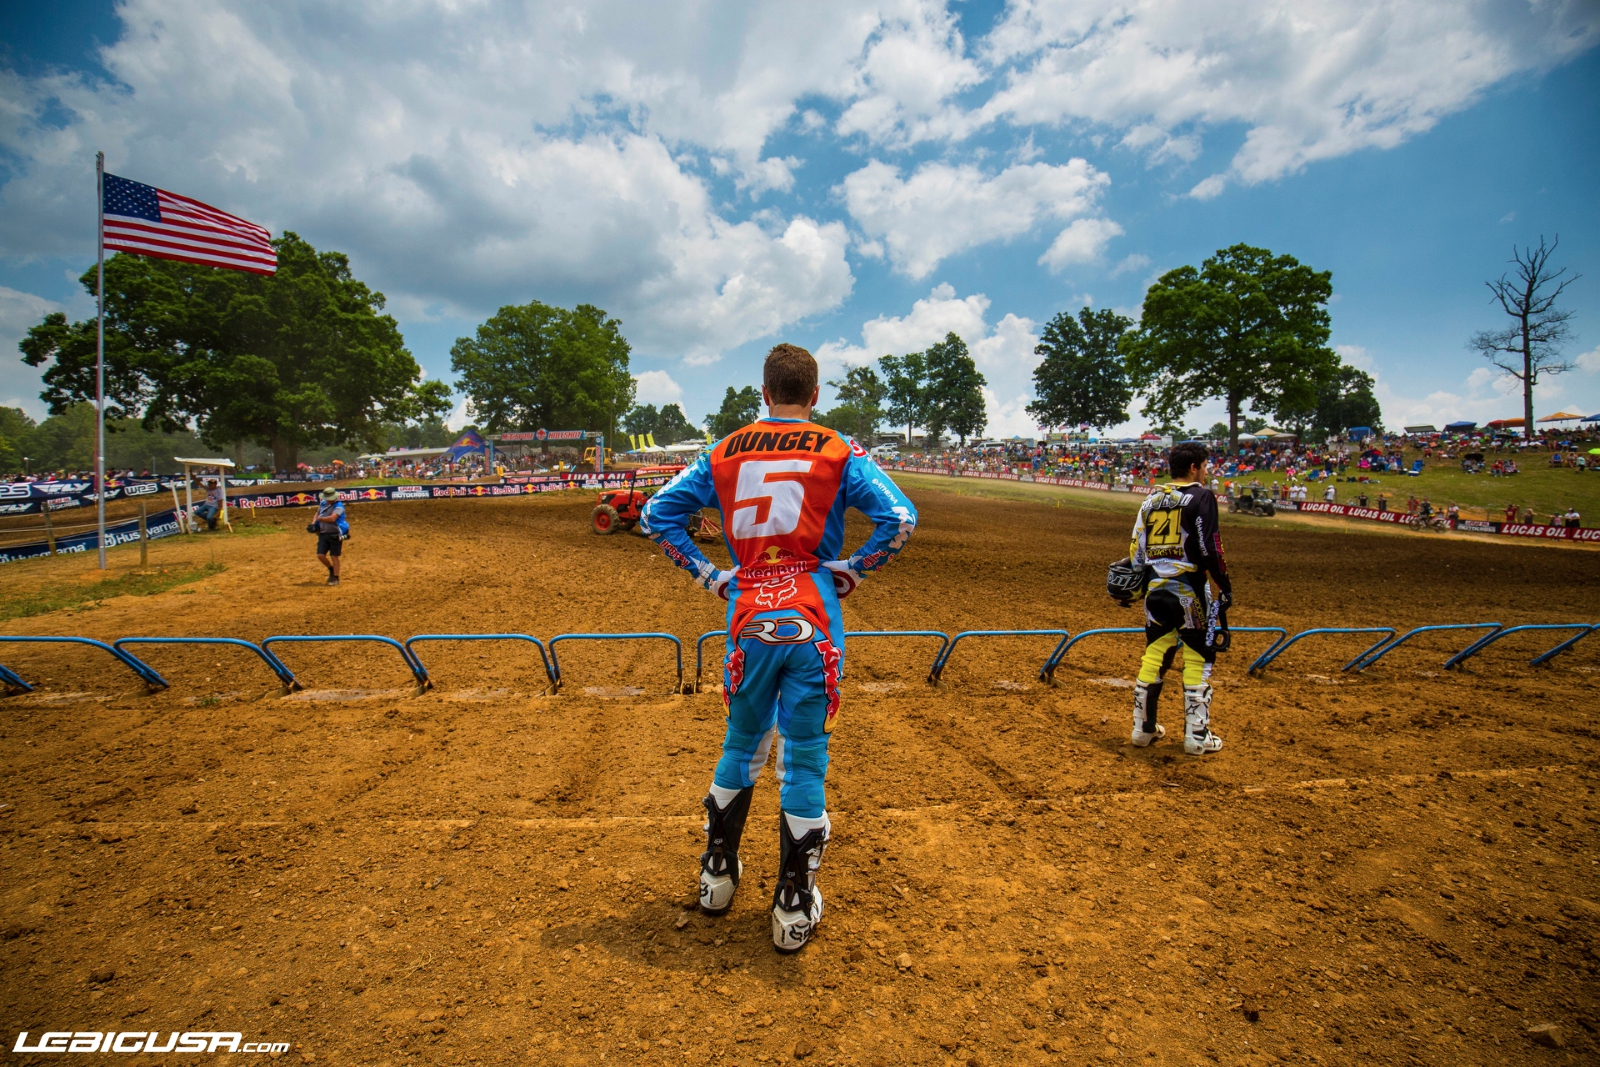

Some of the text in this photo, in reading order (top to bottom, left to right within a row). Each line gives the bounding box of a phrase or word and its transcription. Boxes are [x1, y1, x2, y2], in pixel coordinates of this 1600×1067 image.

[723, 430, 833, 459] DUNGEY
[1035, 476, 1049, 484] LUCAS
[1049, 477, 1057, 485] OIL
[1058, 478, 1083, 487] LUCAS OIL
[1083, 480, 1100, 489] LUCAS
[1100, 482, 1109, 490] OIL
[124, 484, 158, 497] WPS
[339, 490, 358, 501] Bull
[433, 486, 467, 497] Red Bull
[492, 484, 520, 496] Red Bull
[876, 482, 898, 505] ATHENA
[1131, 485, 1150, 494] LUCAS
[239, 494, 284, 508] Red Bull
[731, 458, 813, 541] 5
[1301, 502, 1330, 512] LUCAS
[1330, 505, 1345, 514] OIL
[1347, 507, 1379, 519] LUCAS
[1379, 511, 1395, 521] OIL
[1146, 507, 1183, 546] 21
[1457, 523, 1496, 533] MOTOCROSS
[1501, 524, 1567, 538] LUCAS OIL
[743, 560, 807, 578] Red Bull
